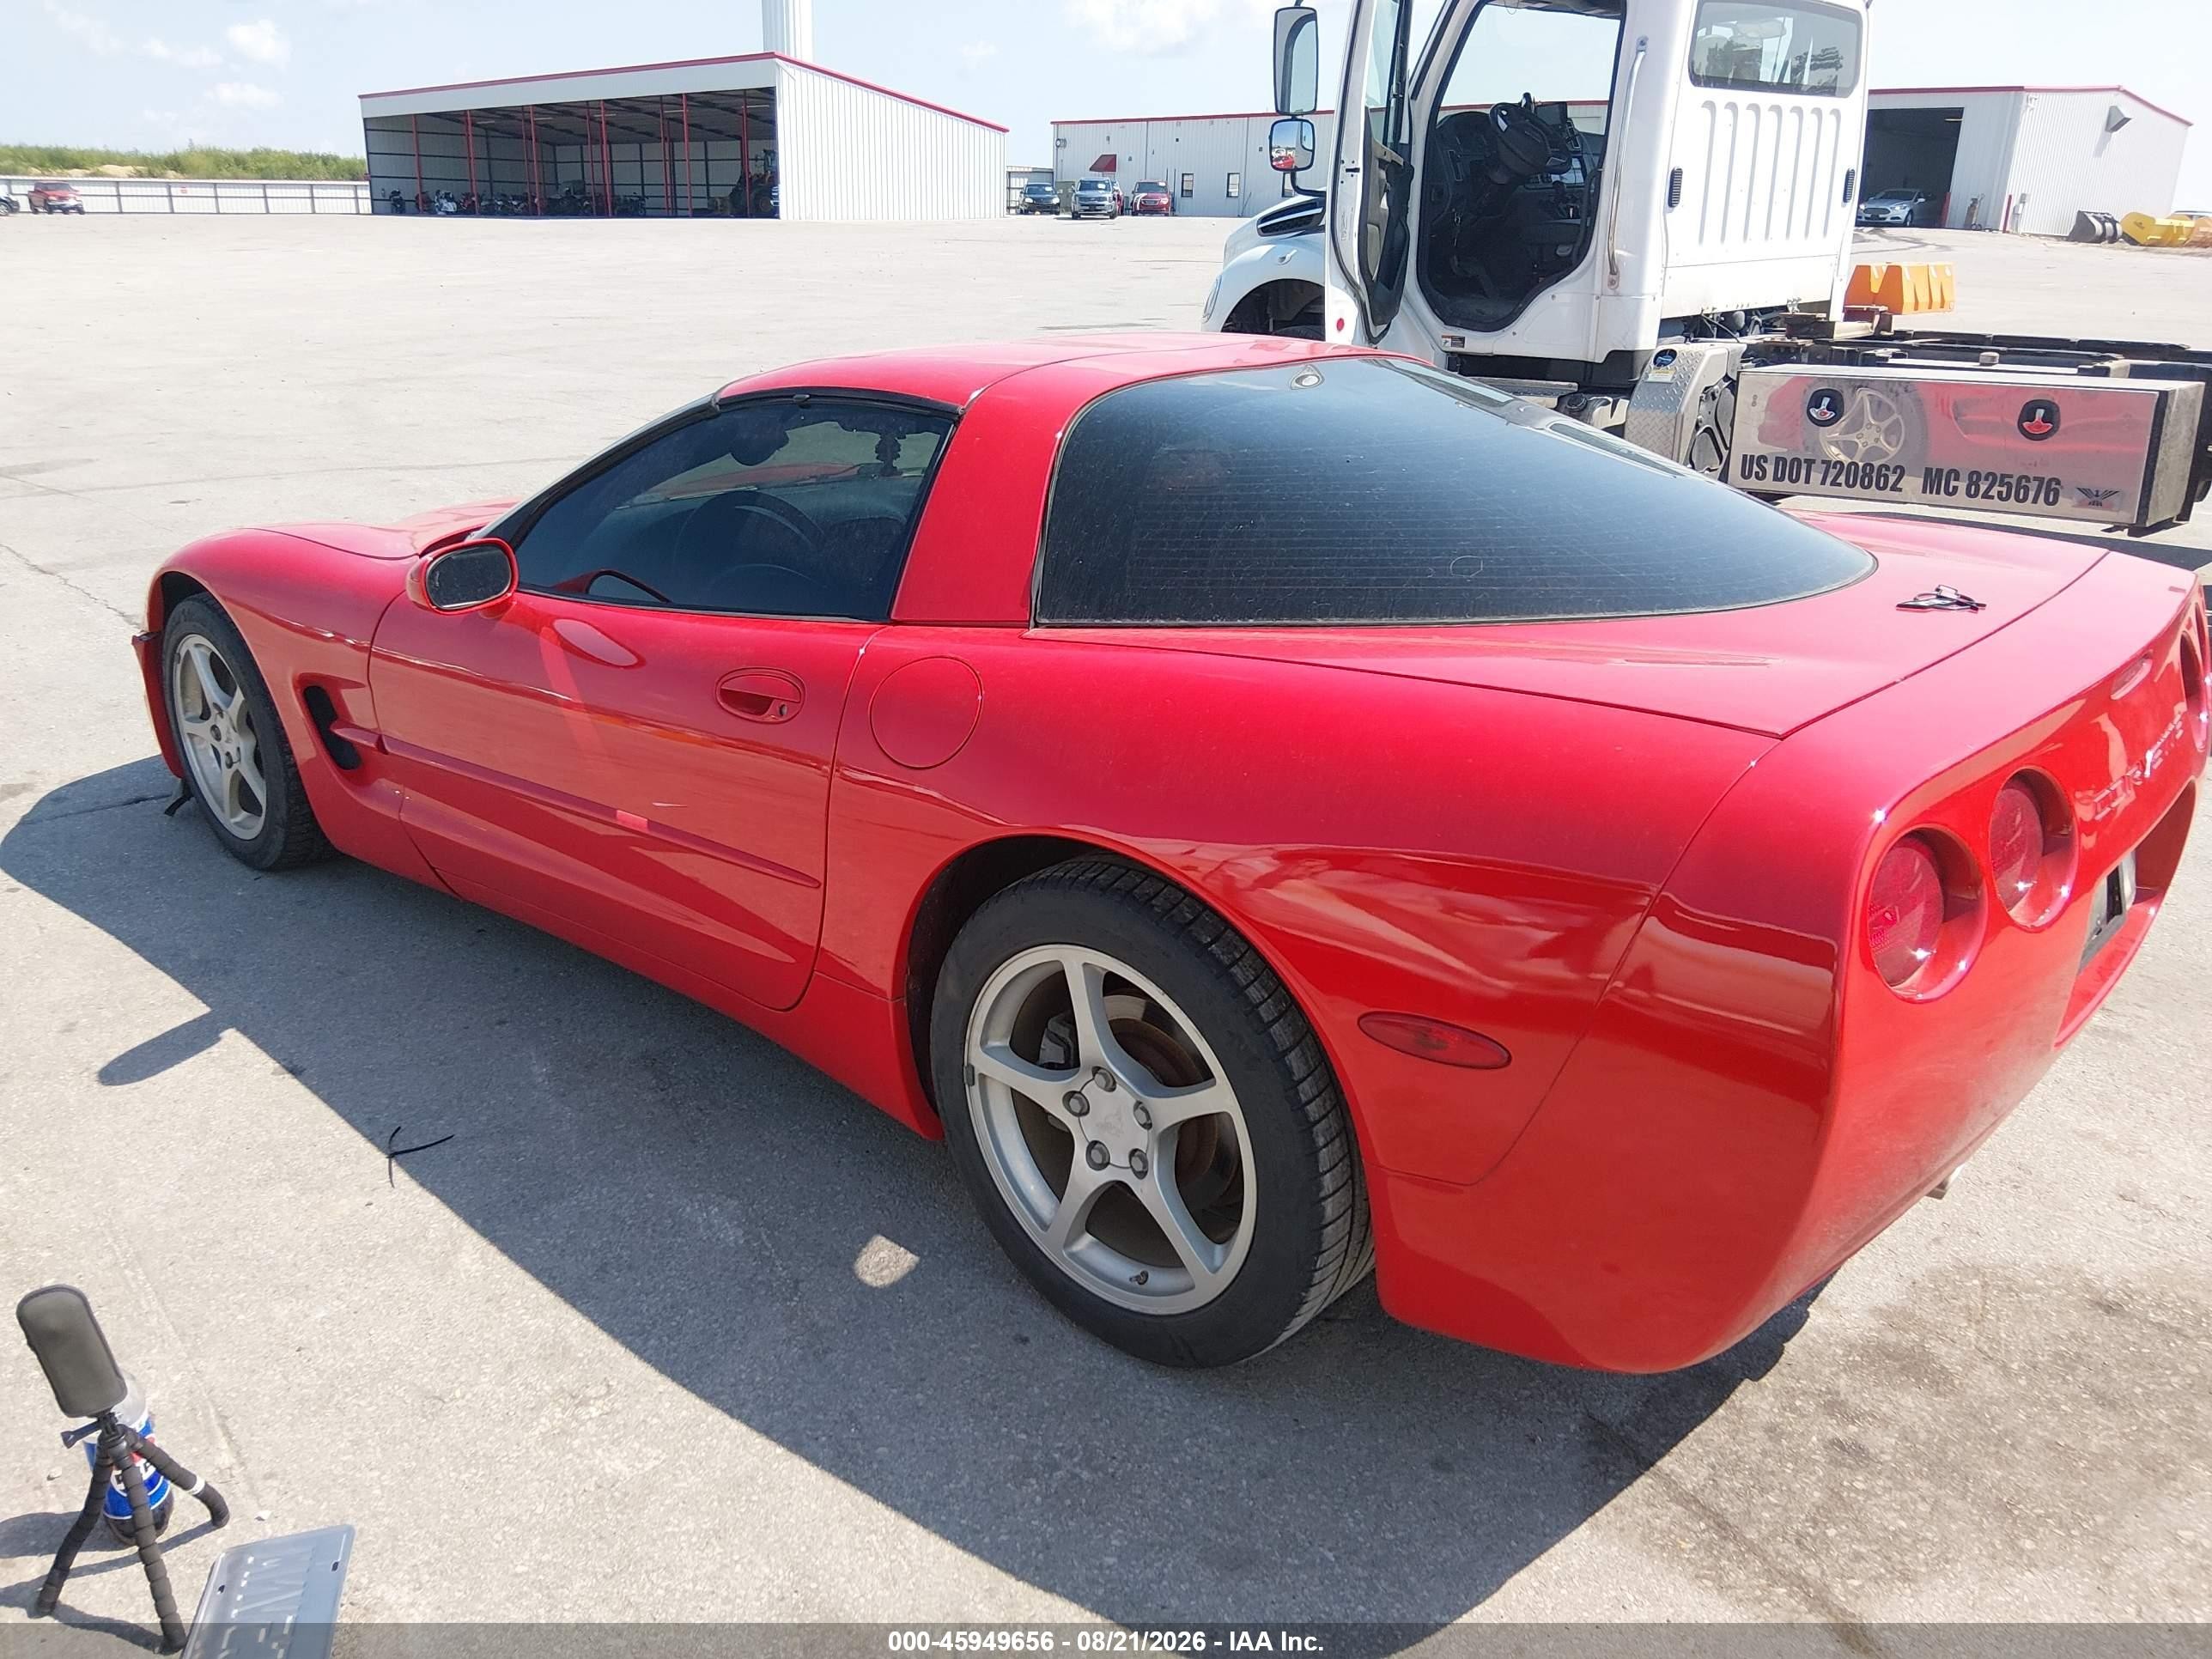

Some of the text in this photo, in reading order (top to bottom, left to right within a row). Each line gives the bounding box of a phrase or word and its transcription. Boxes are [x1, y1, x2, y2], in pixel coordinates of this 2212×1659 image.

[1741, 454, 2061, 506] US DOT 720862 MC 825676
